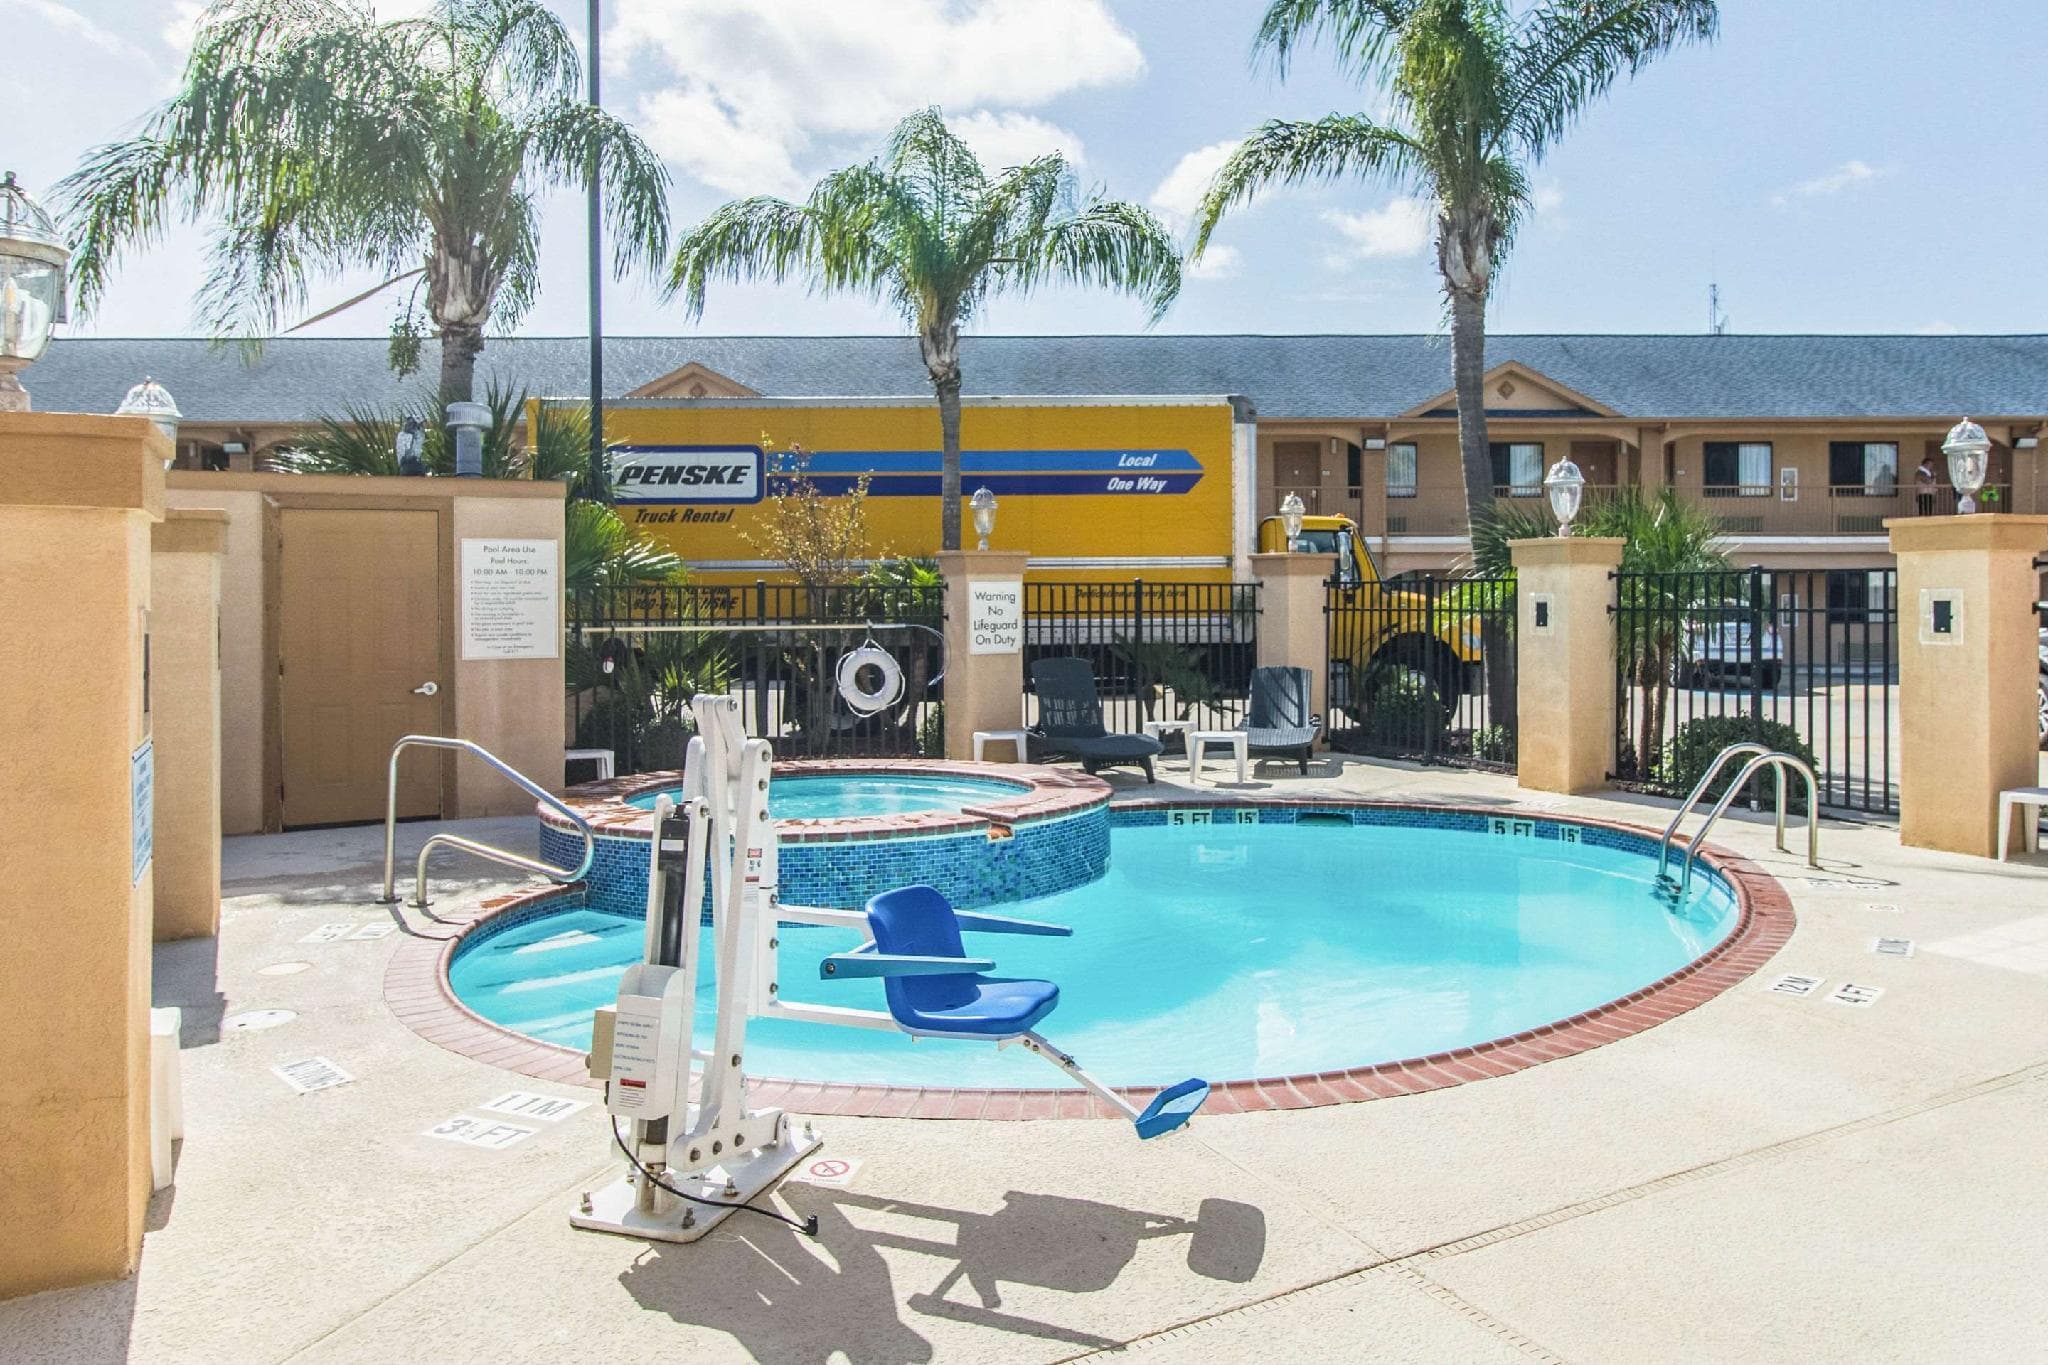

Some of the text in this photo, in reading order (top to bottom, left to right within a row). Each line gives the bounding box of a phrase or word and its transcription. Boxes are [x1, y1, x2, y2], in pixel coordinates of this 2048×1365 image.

[1118, 453, 1158, 467] Local
[616, 465, 751, 485] PENSKE
[1107, 477, 1168, 493] One Way
[634, 508, 735, 523] Truck Rental
[482, 544, 537, 554] Pool Area Use
[490, 557, 506, 565] Pool
[515, 568, 535, 576] 10:00
[536, 568, 548, 576] PM
[974, 591, 1017, 605] Warning
[988, 605, 1004, 616] No
[973, 619, 1018, 633] Lifeguard
[975, 634, 1017, 648] On Duty
[1173, 812, 1211, 826] 5 FT
[1494, 820, 1533, 838] 5 FT
